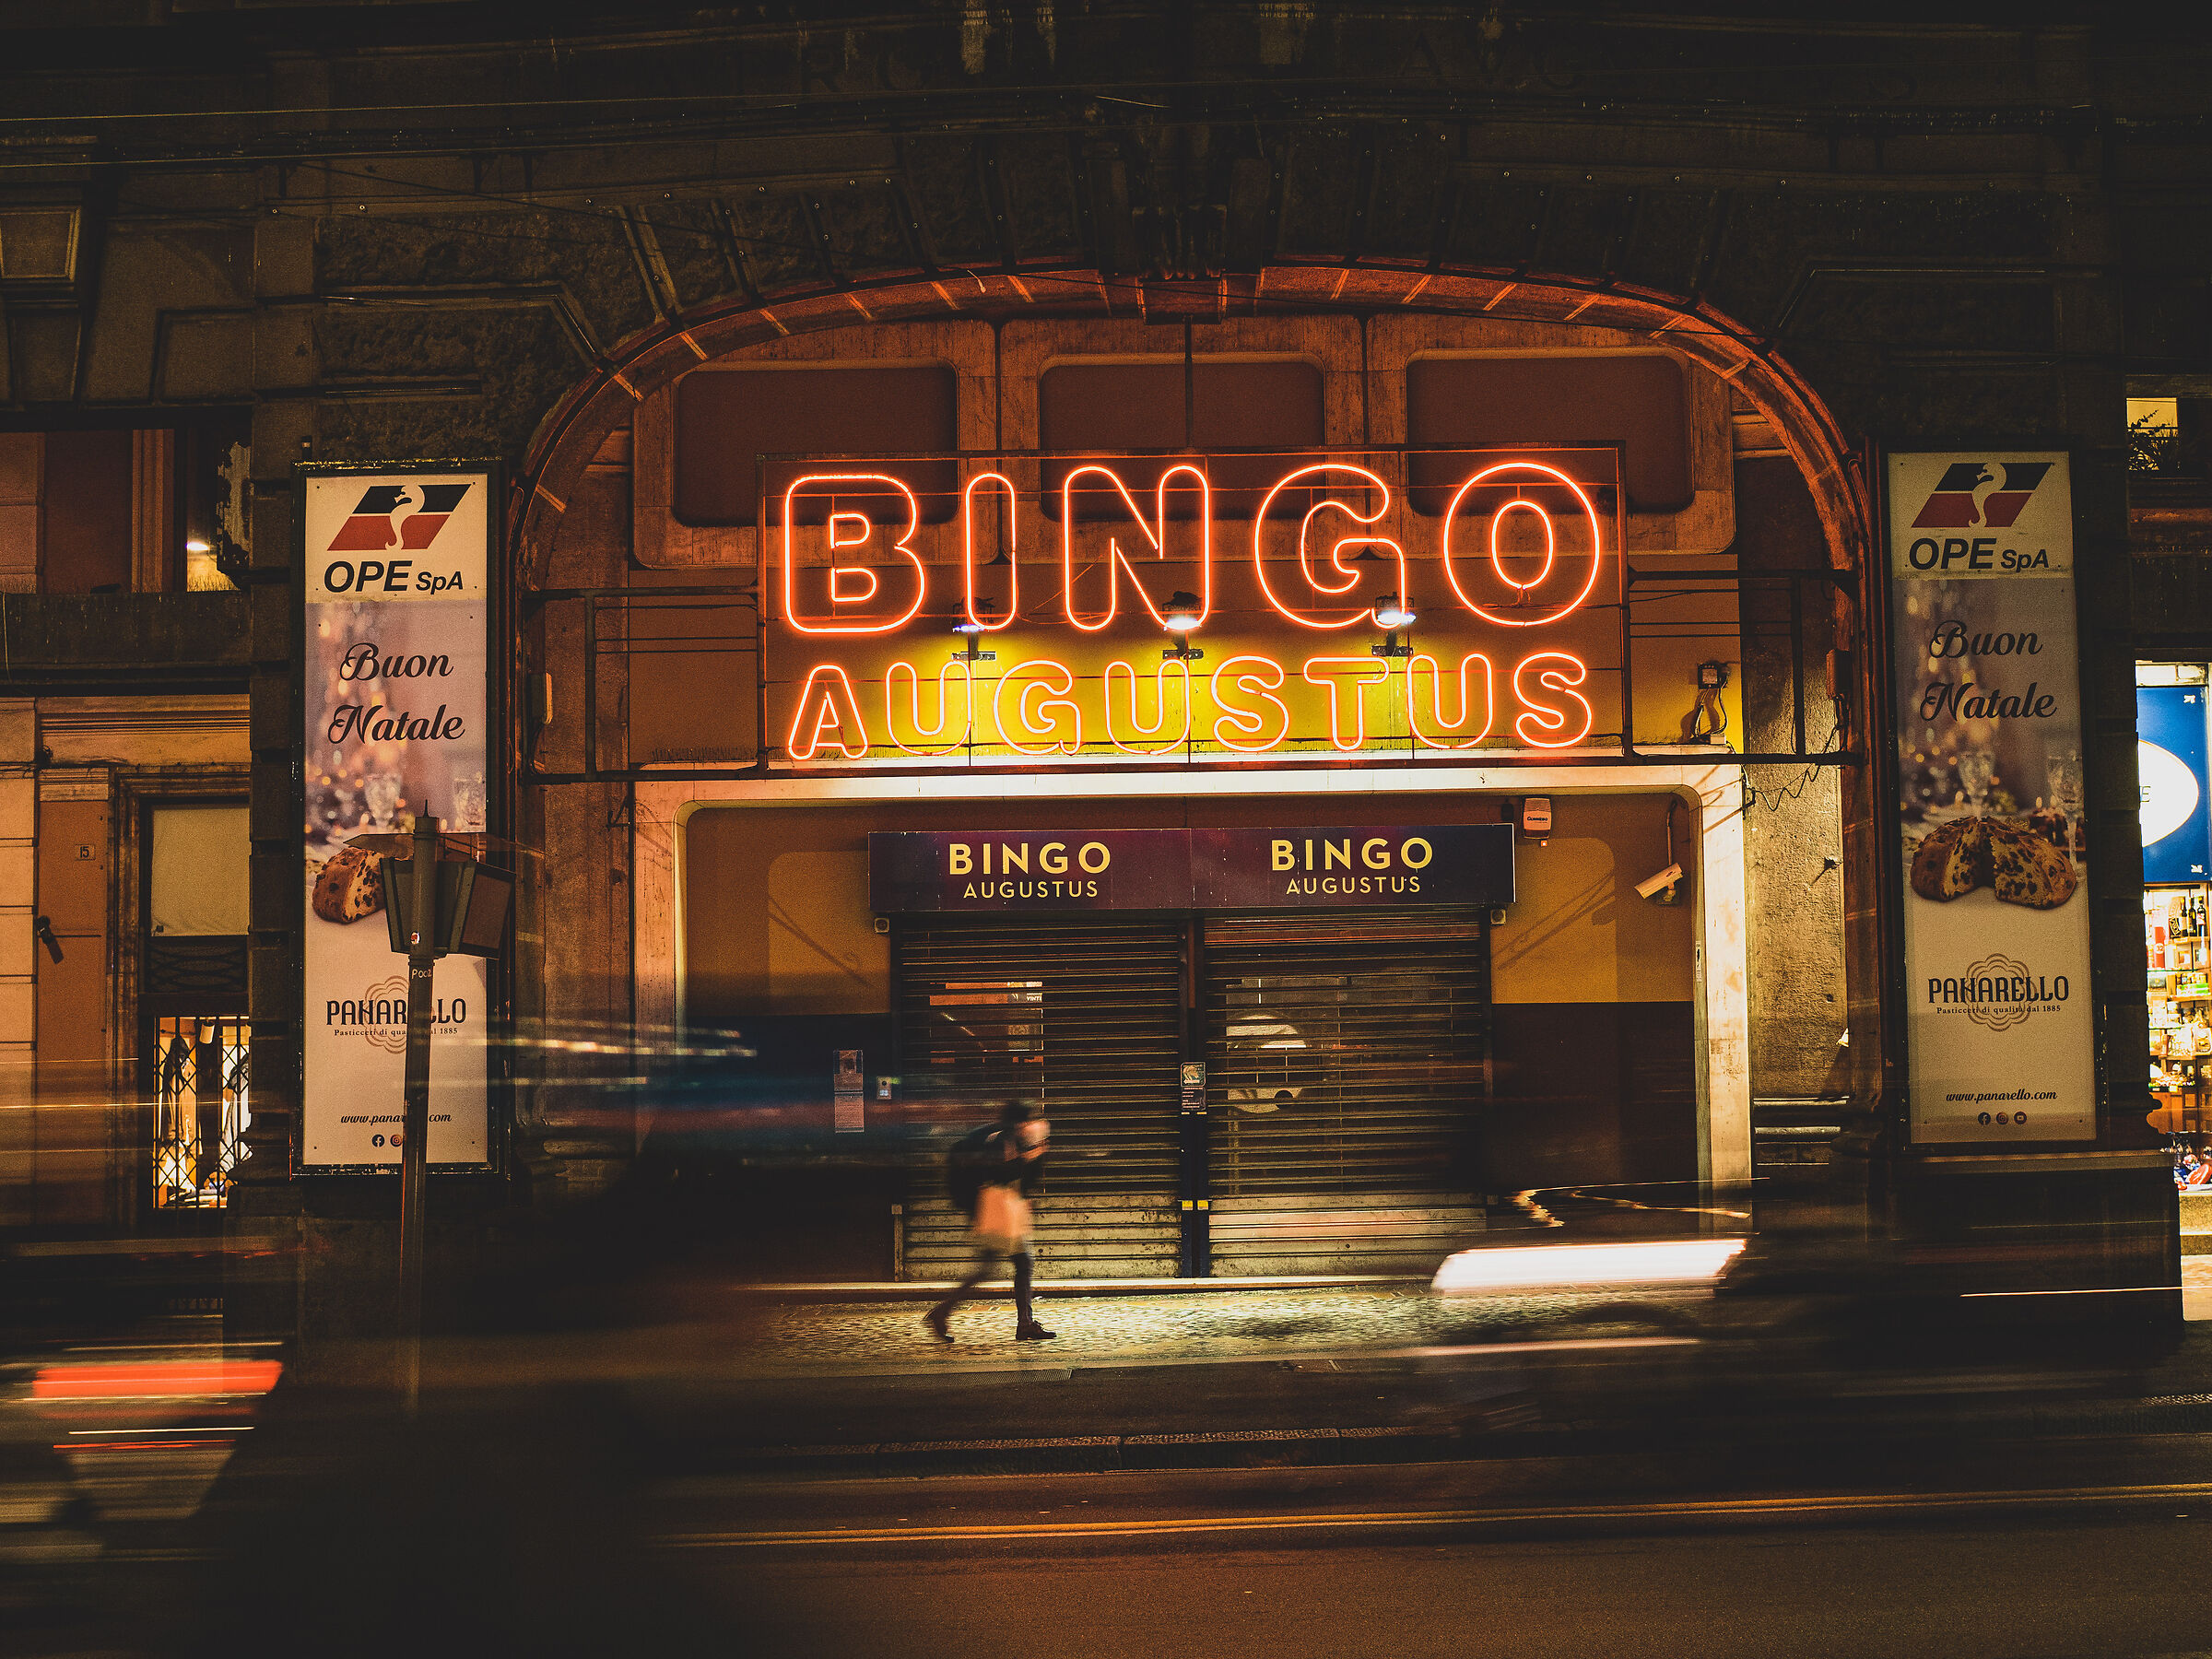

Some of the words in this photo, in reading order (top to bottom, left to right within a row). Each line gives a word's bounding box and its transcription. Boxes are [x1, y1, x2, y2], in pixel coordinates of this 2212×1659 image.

[783, 462, 1602, 632] BINGO
[1909, 537, 1997, 571] OPE
[2000, 549, 2050, 572] SpA
[324, 560, 413, 593] OPE
[415, 571, 464, 594] SpA
[1928, 619, 2043, 659] Buon
[339, 642, 454, 681] Buon
[786, 651, 1594, 761] AUGUSTUS
[1920, 682, 2058, 723] Natale
[327, 704, 465, 745] Natale
[949, 841, 1111, 875] BINGO
[1271, 837, 1433, 871] BINGO
[963, 880, 1098, 899] AUGUSTUS
[1286, 876, 1420, 895] AUGUSTUS
[1927, 975, 2070, 1004] PANARELLO
[326, 998, 466, 1025] PANARLO
[1946, 1088, 2057, 1103] www.panarello.com
